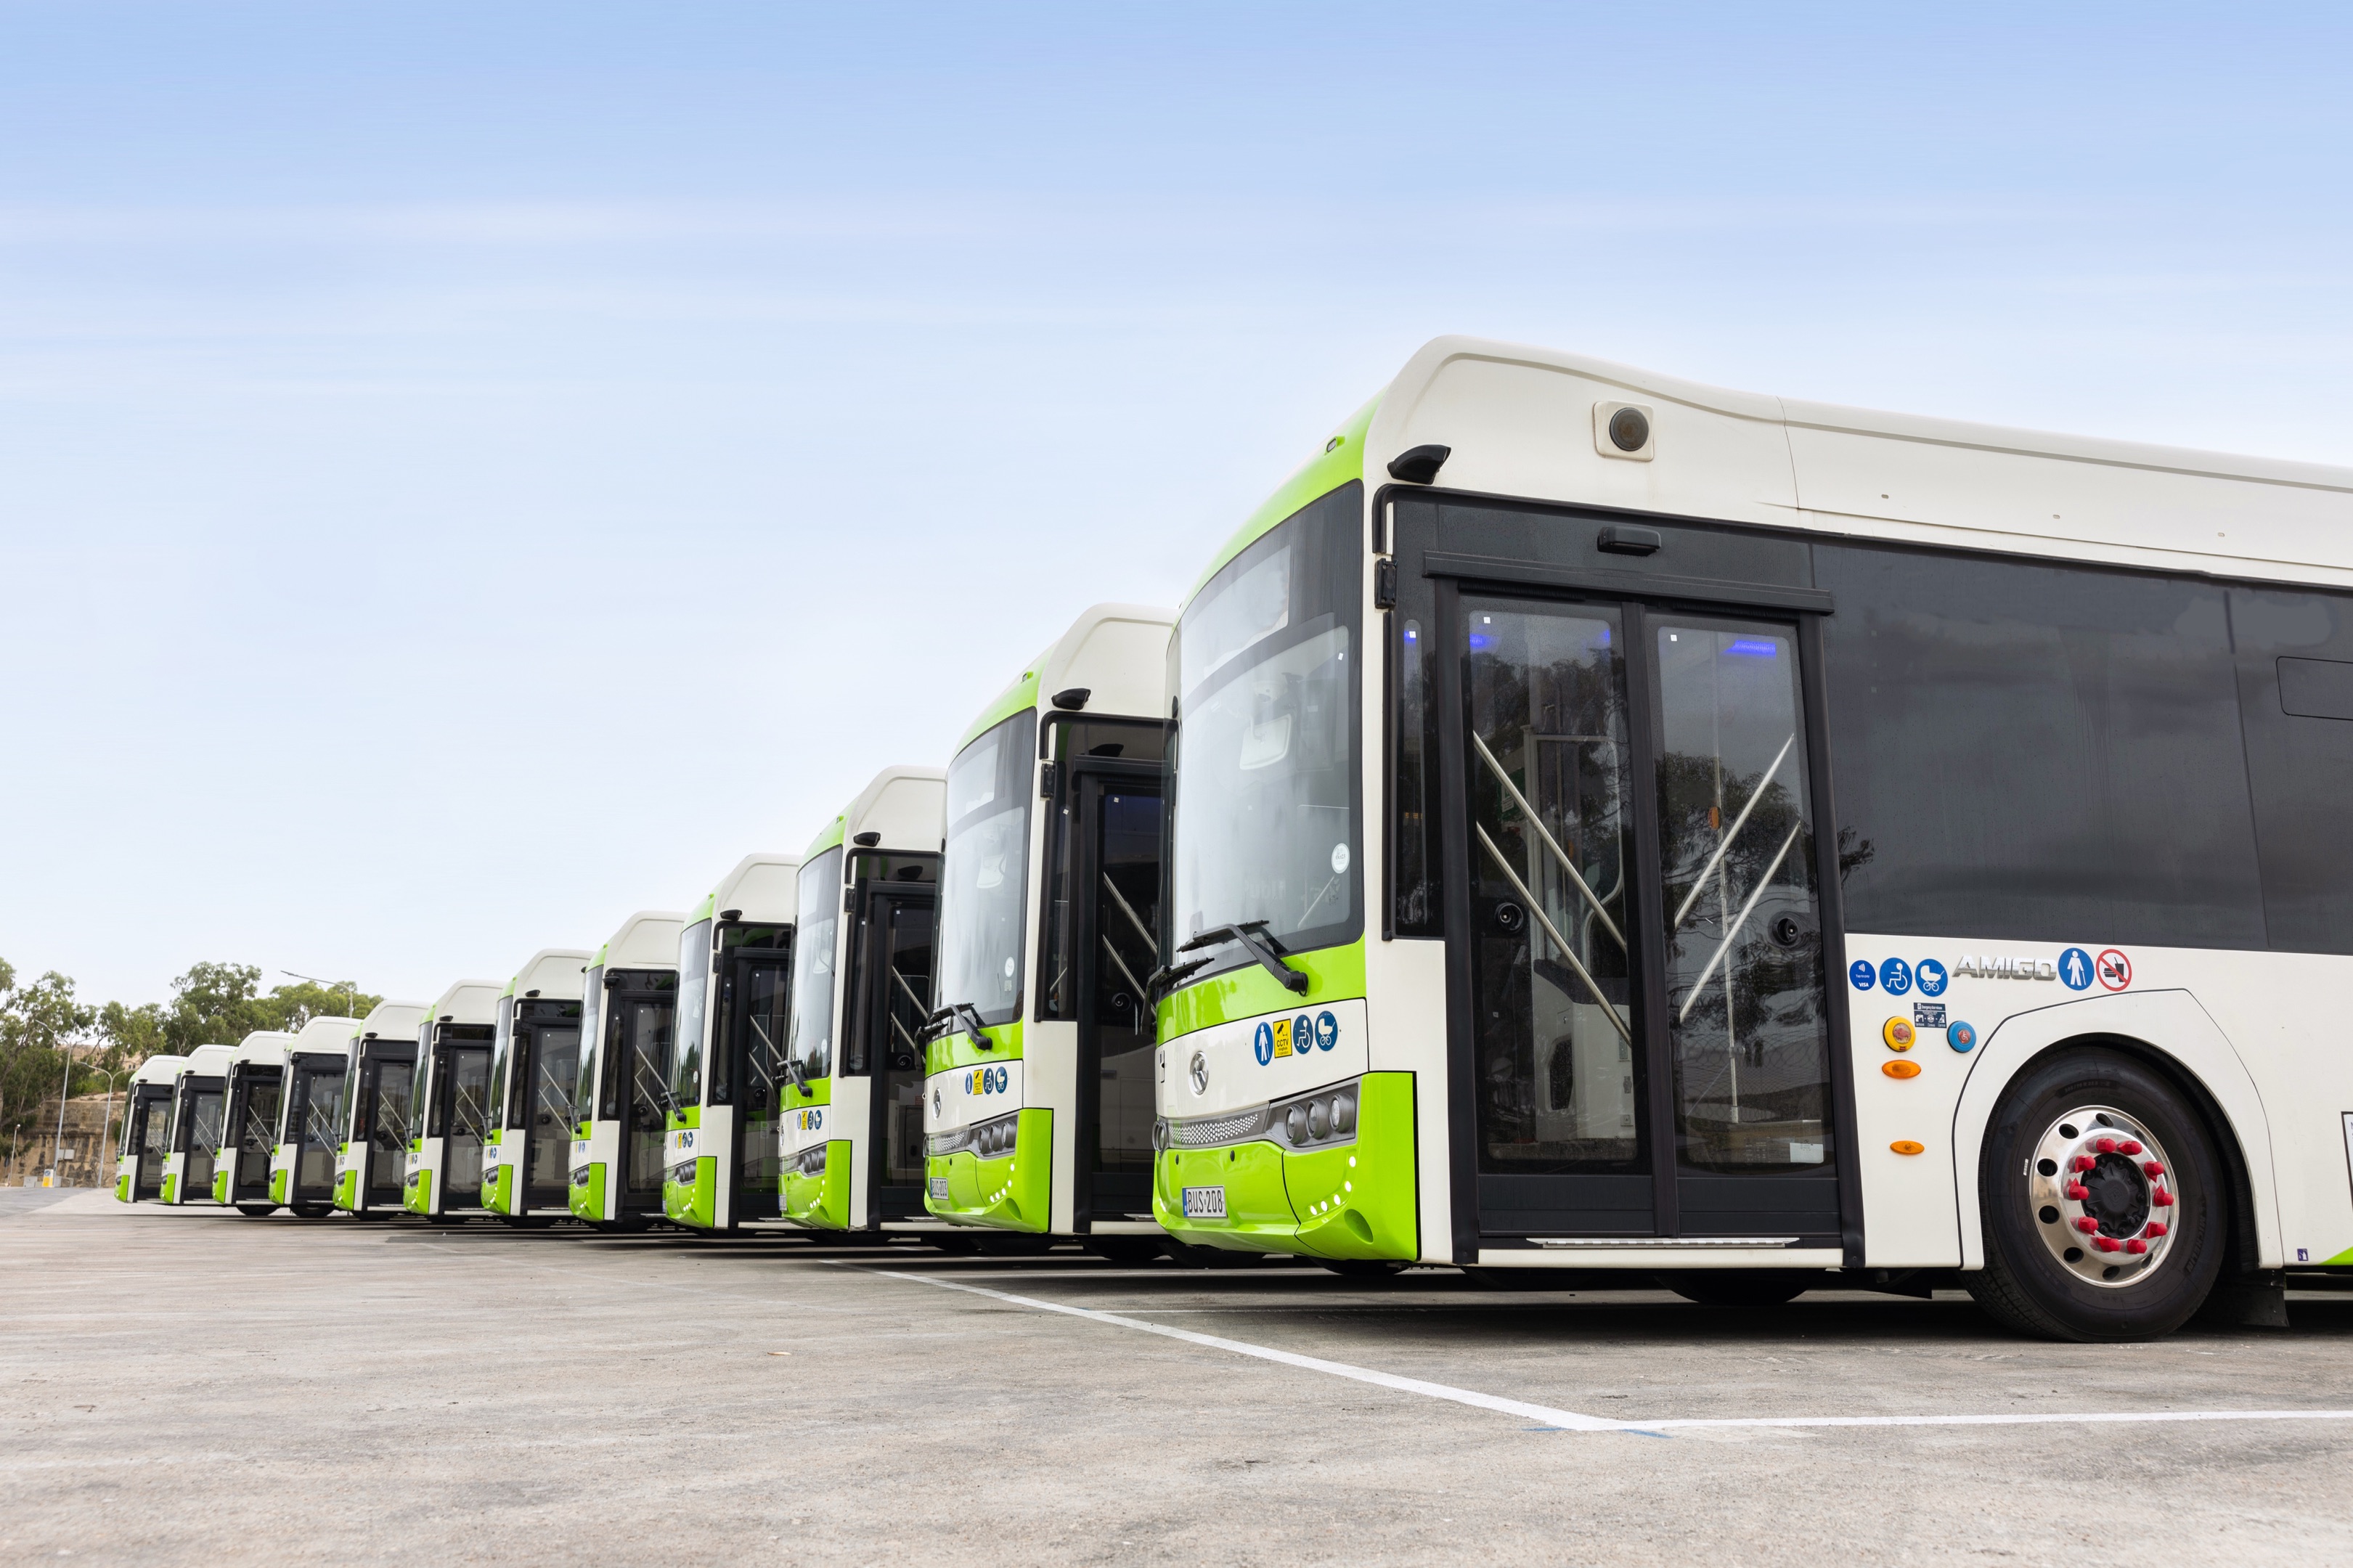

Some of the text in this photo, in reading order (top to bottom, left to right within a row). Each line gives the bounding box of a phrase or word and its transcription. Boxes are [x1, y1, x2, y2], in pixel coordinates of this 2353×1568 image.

[1952, 955, 2057, 981] AMIGO
[1188, 1190, 1223, 1213] BUS 208
